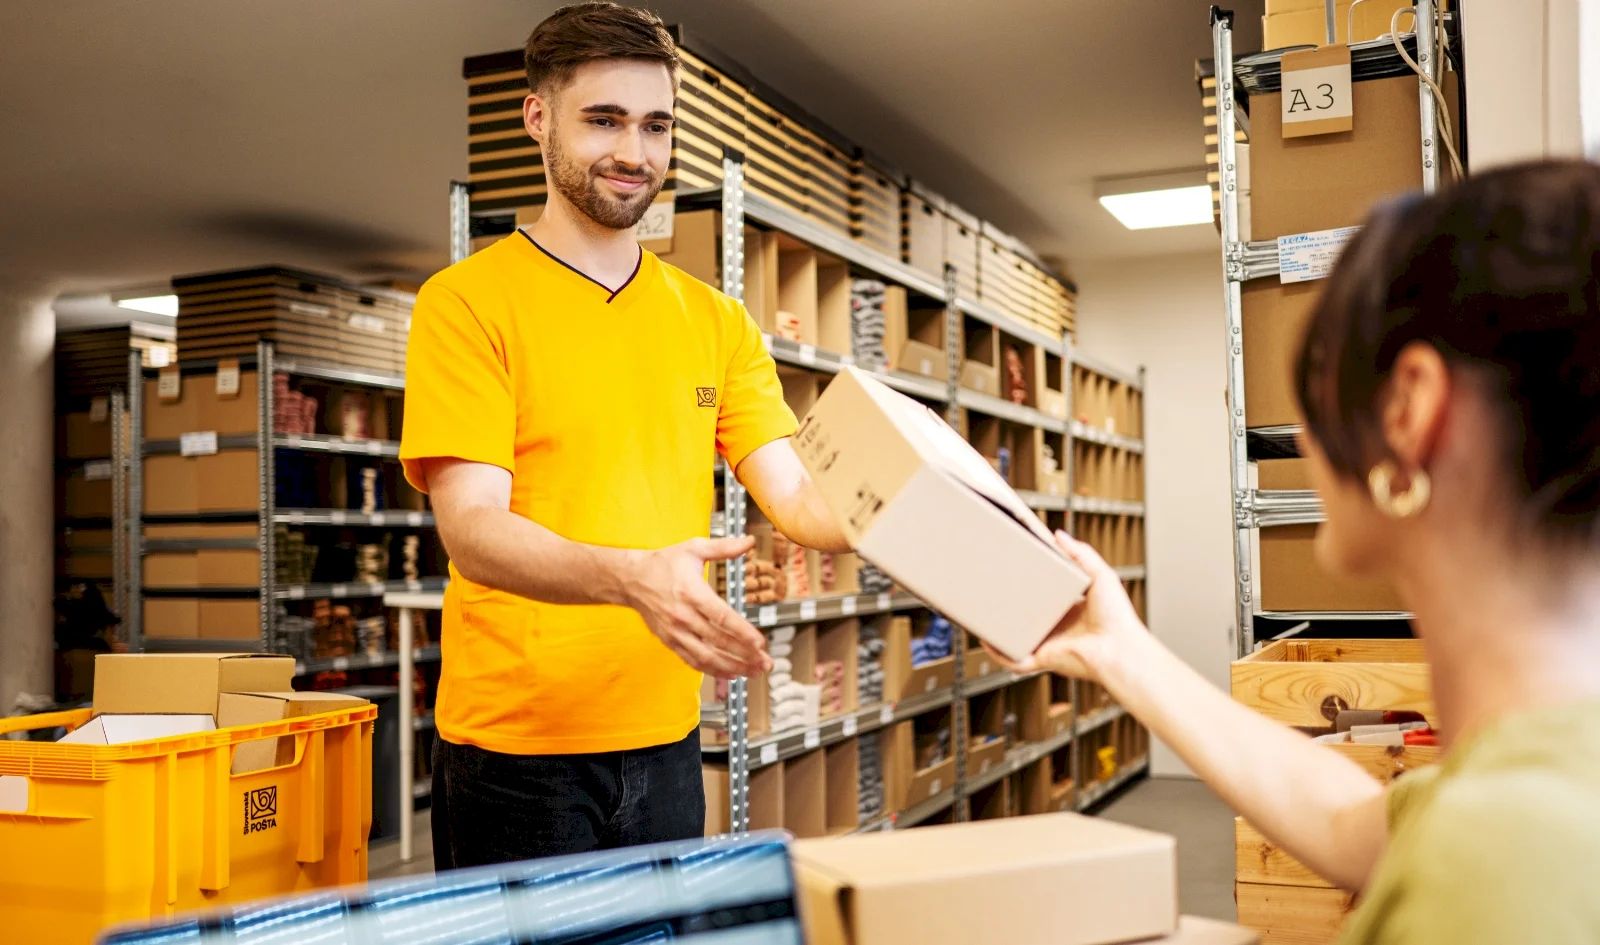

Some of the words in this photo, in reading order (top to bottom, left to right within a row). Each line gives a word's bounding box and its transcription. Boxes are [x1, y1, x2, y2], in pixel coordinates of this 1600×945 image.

[1288, 83, 1334, 113] A3
[636, 213, 667, 235] A2
[250, 818, 277, 833] POŠTA
